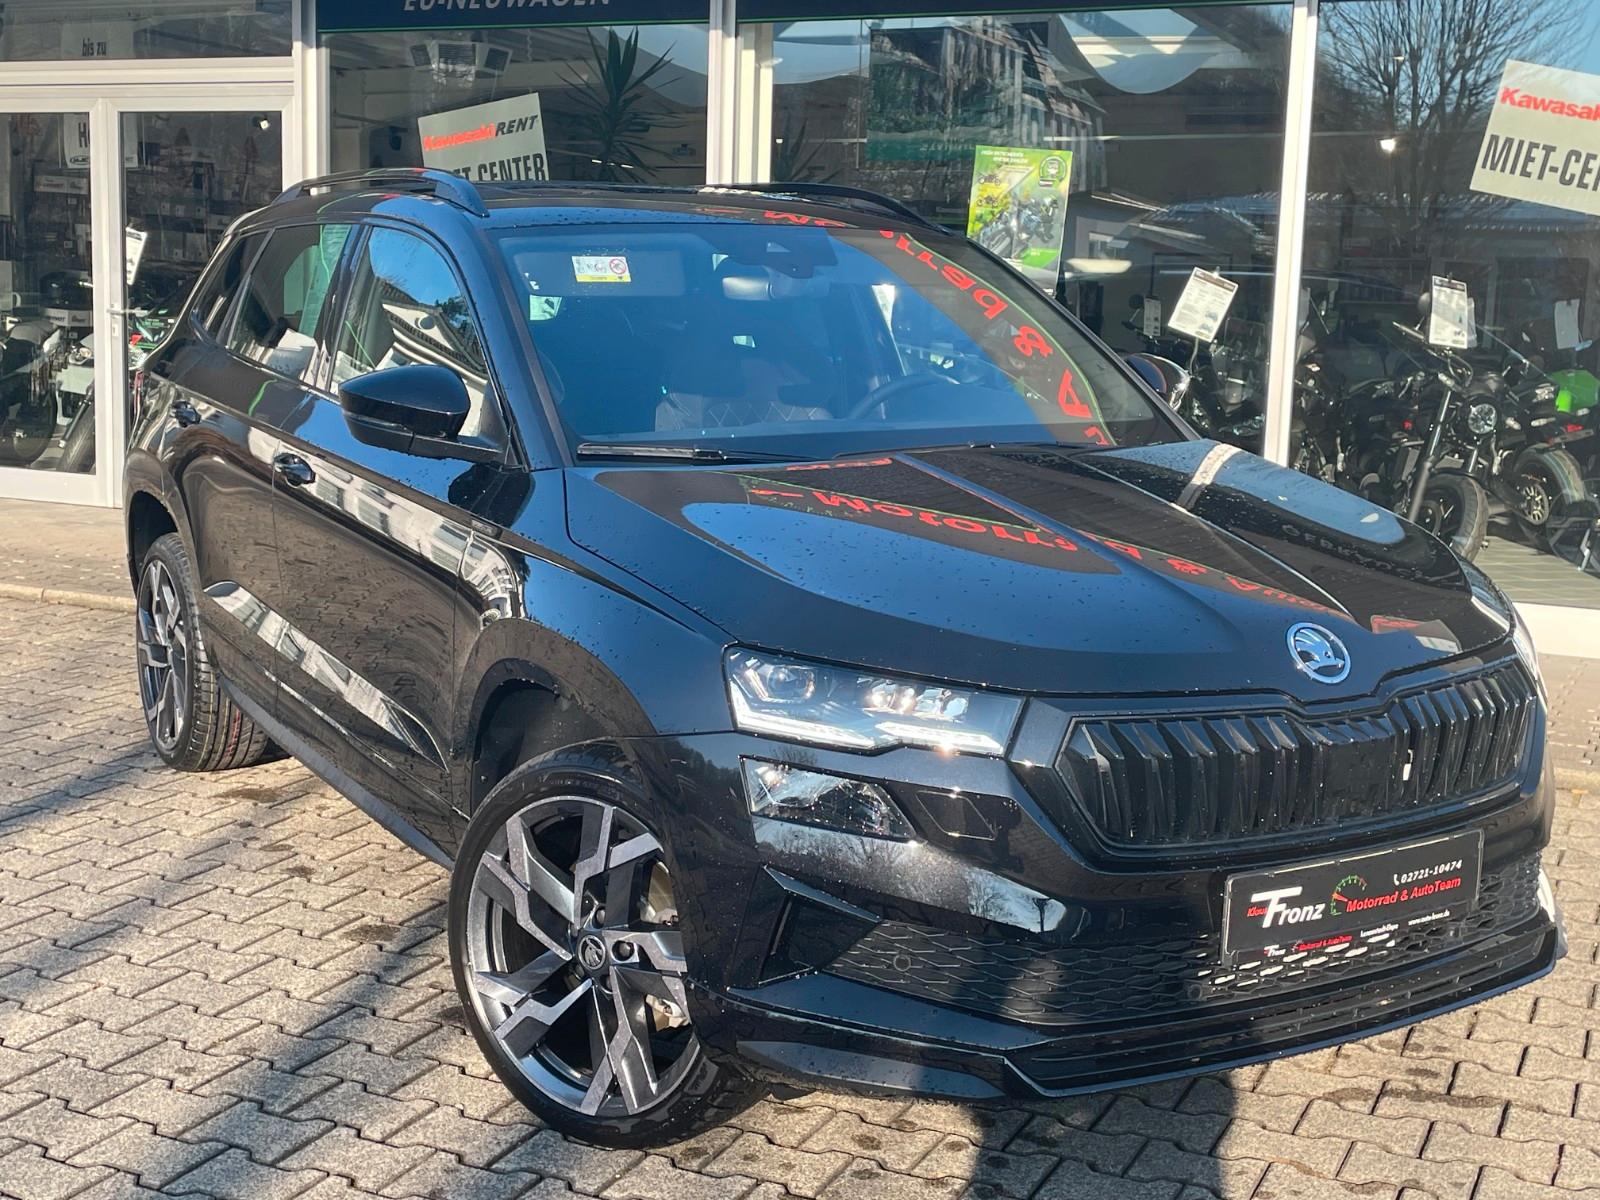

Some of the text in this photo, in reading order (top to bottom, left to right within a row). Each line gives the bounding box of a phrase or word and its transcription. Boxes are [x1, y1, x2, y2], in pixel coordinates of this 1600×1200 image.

[1401, 859, 1463, 884] 02721-10474
[1346, 877, 1461, 913] Motorrad & AutoTeam
